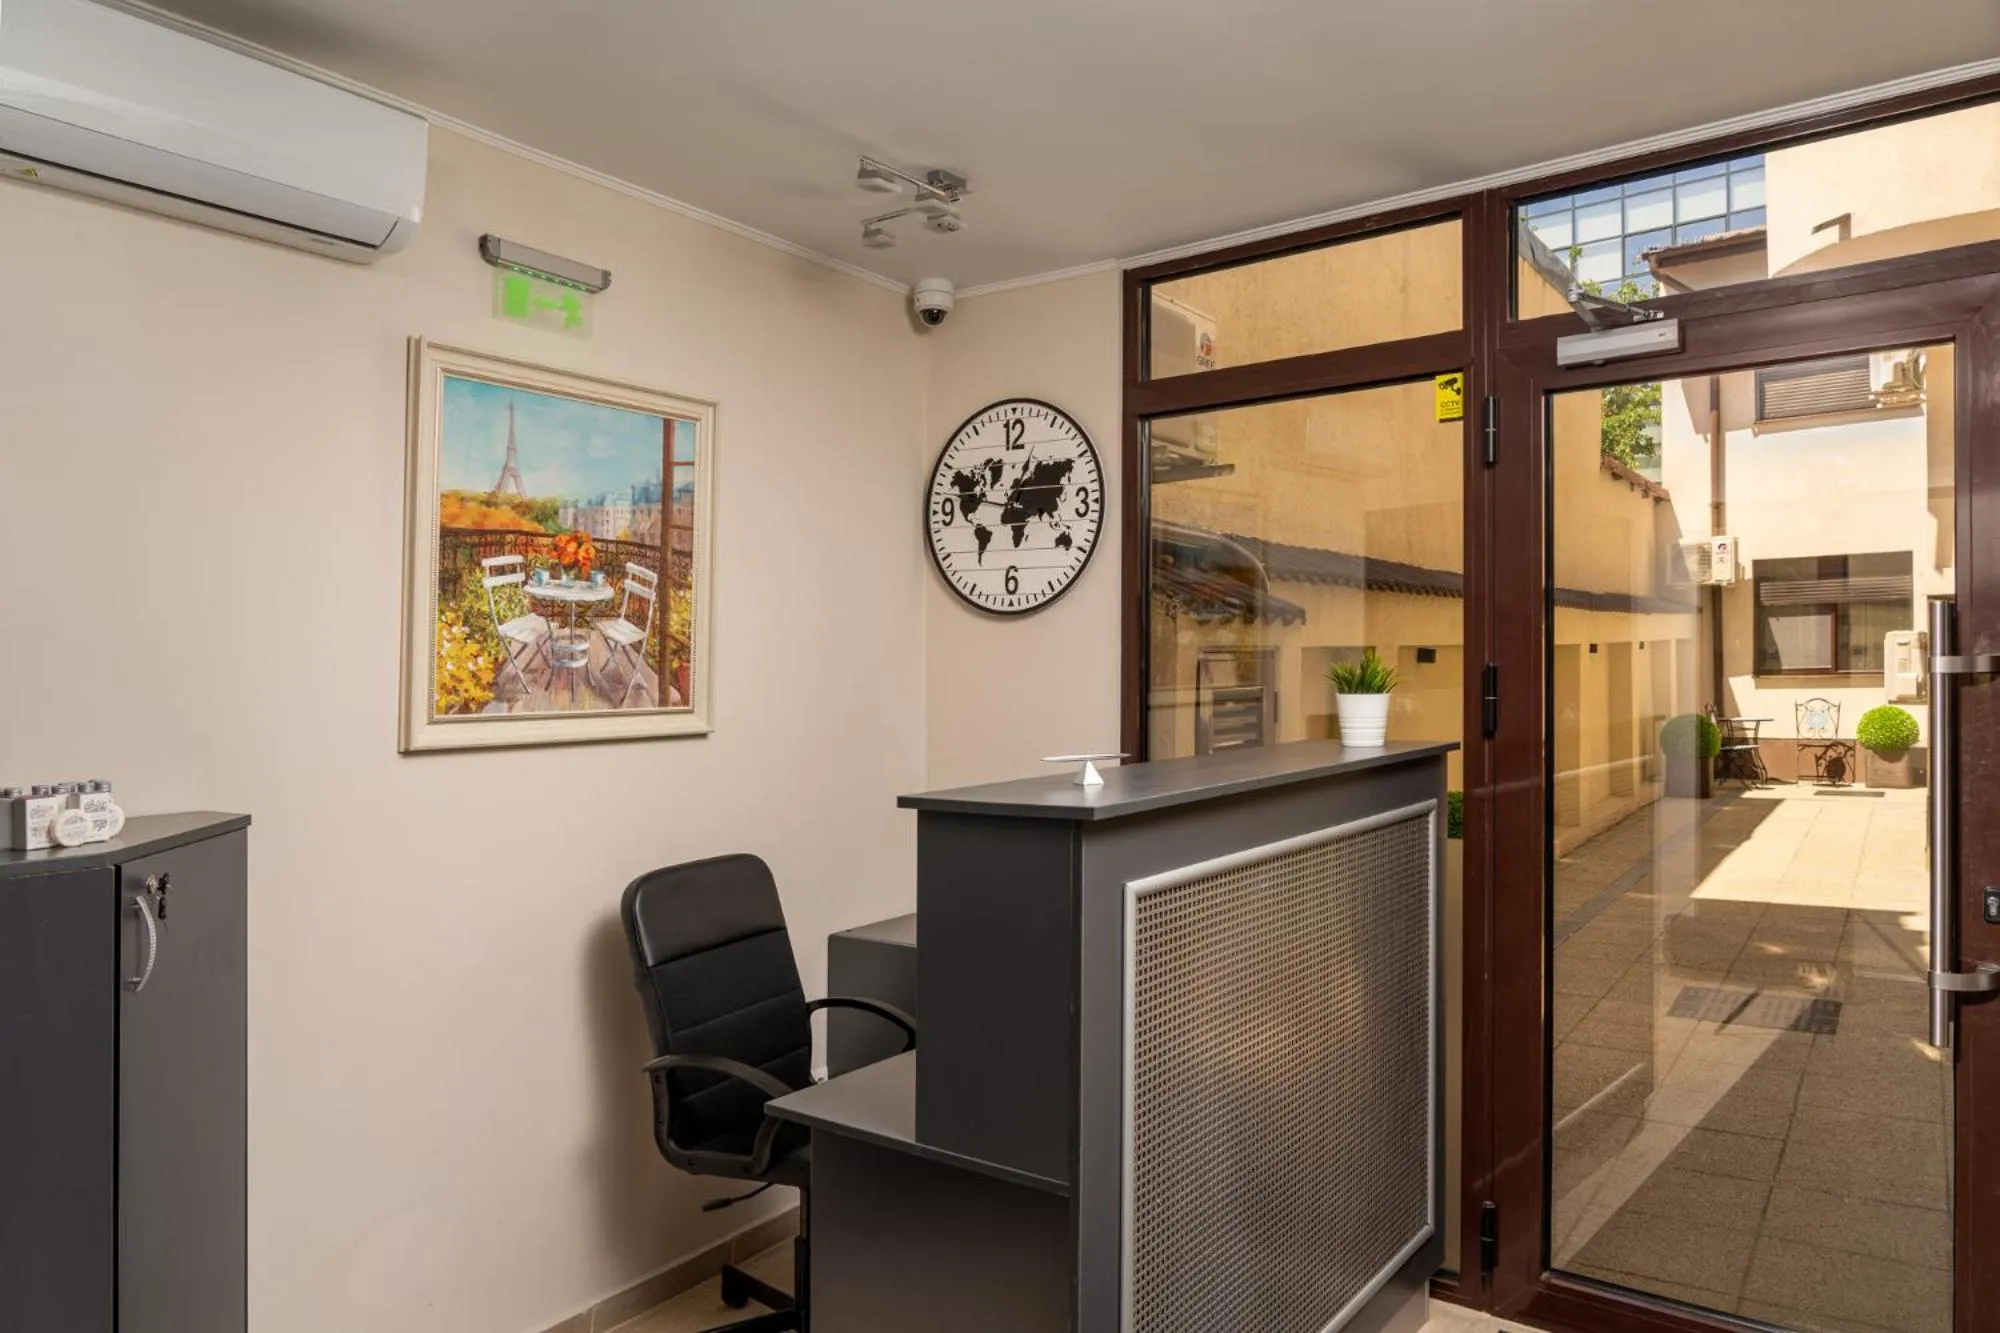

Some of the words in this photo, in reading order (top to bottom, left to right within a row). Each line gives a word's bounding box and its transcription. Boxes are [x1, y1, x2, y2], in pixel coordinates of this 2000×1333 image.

[1003, 418, 1025, 451] 12
[941, 497, 954, 526] 9
[1075, 486, 1090, 518] 3
[1004, 565, 1019, 595] 6
